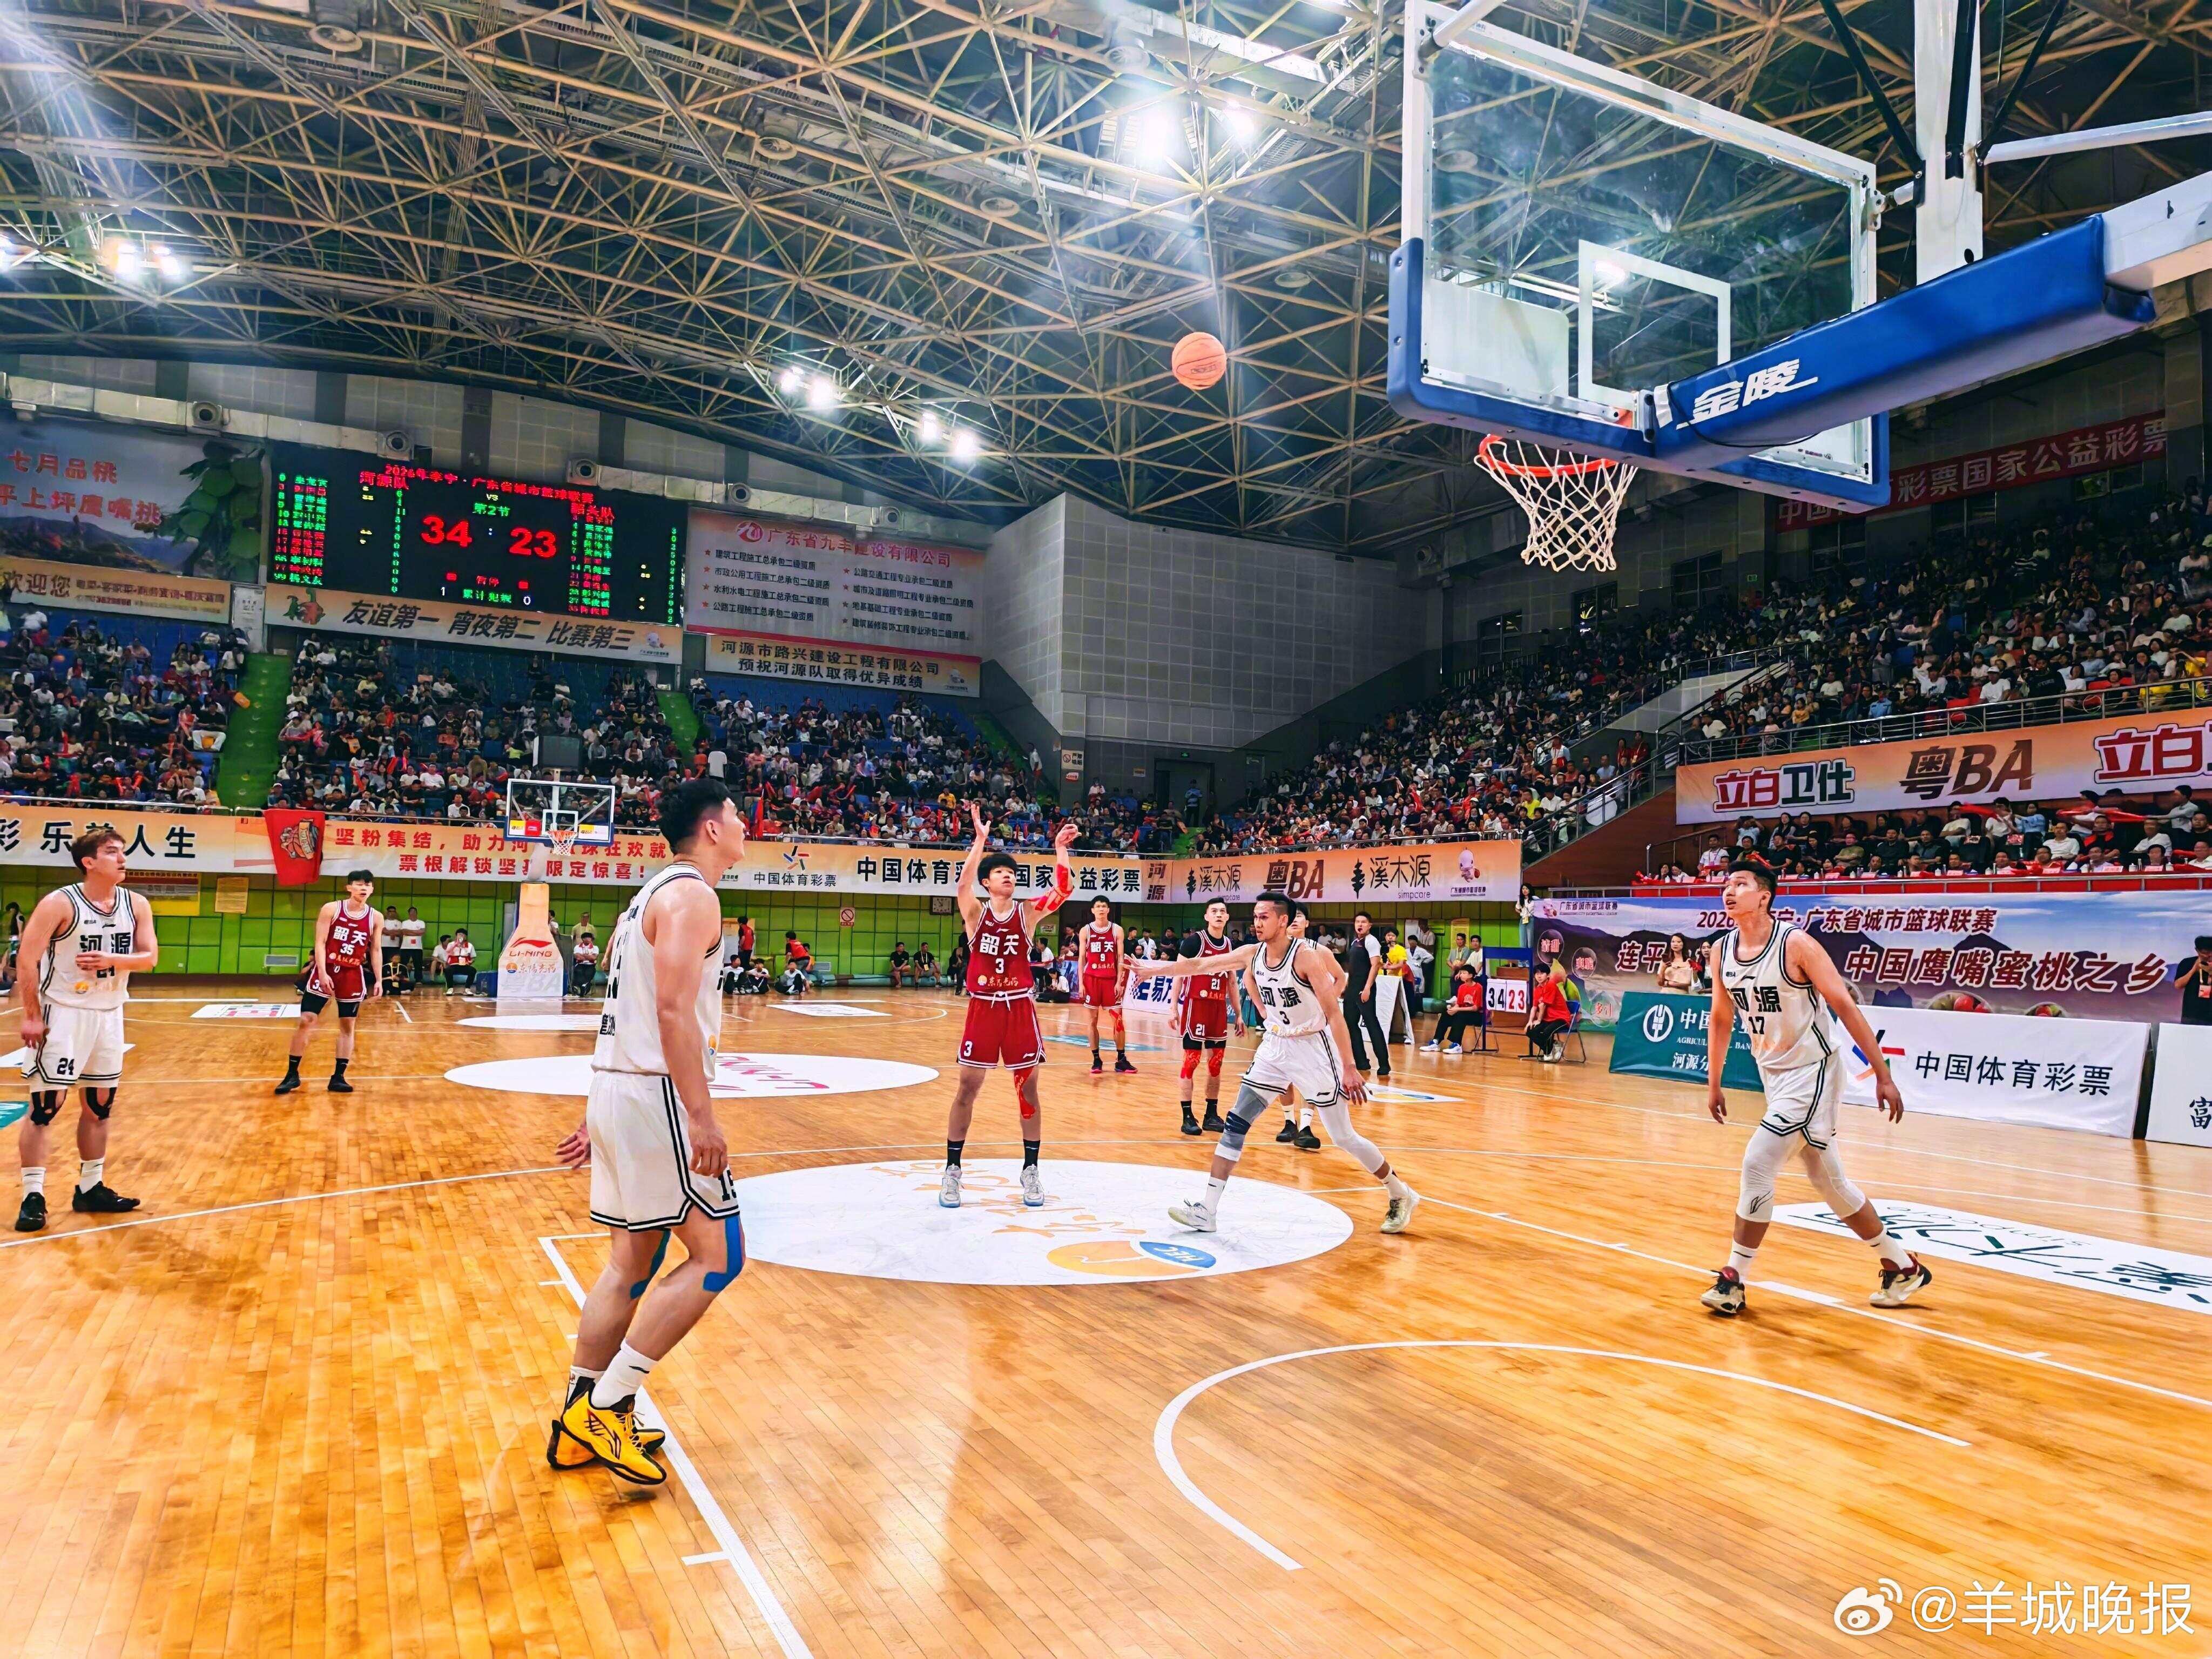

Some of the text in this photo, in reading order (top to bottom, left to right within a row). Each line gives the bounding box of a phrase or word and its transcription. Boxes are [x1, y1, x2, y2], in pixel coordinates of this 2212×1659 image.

[1676, 359, 1818, 430] 金陵
[5, 449, 118, 484] 七月品桃
[1779, 419, 2167, 525] 中国彩票国家公益彩票
[473, 503, 510, 517] 第2节
[421, 515, 472, 548] 34
[509, 527, 557, 558] 23
[767, 528, 950, 568] 广东省九丰建设有限公司
[523, 596, 531, 605] 0
[342, 599, 635, 651] 友谊第一 宵夜第二 比赛第三
[721, 640, 939, 676] 河源市路兴建设工程有限公司
[738, 658, 923, 690] 预祝河源队取得优异成绩
[1715, 724, 2212, 811] 立白卫仕 粤BA 立白
[41, 821, 196, 859] 乐人生
[754, 872, 837, 887] 中国体育彩票
[1199, 854, 1432, 899] 溪木源 粤BA 溪木源
[1560, 901, 1618, 911] 广东省城市篮球联赛
[340, 943, 355, 955] 35
[1100, 953, 1105, 962] 9
[995, 958, 1004, 974] 3
[1845, 947, 2166, 992] 中国鹰嘴蜜桃之乡
[1211, 978, 1220, 990] 21
[1488, 982, 1526, 1009] 34 23
[1085, 995, 1091, 1003] 9
[1195, 1023, 1205, 1036] 21
[1279, 1010, 1290, 1025] 3
[1748, 1016, 1765, 1035] 17
[963, 1041, 973, 1057] 3
[57, 1058, 75, 1076] 24
[1915, 1049, 2114, 1097] 中国体育彩票
[2189, 1096, 2212, 1130] 富
